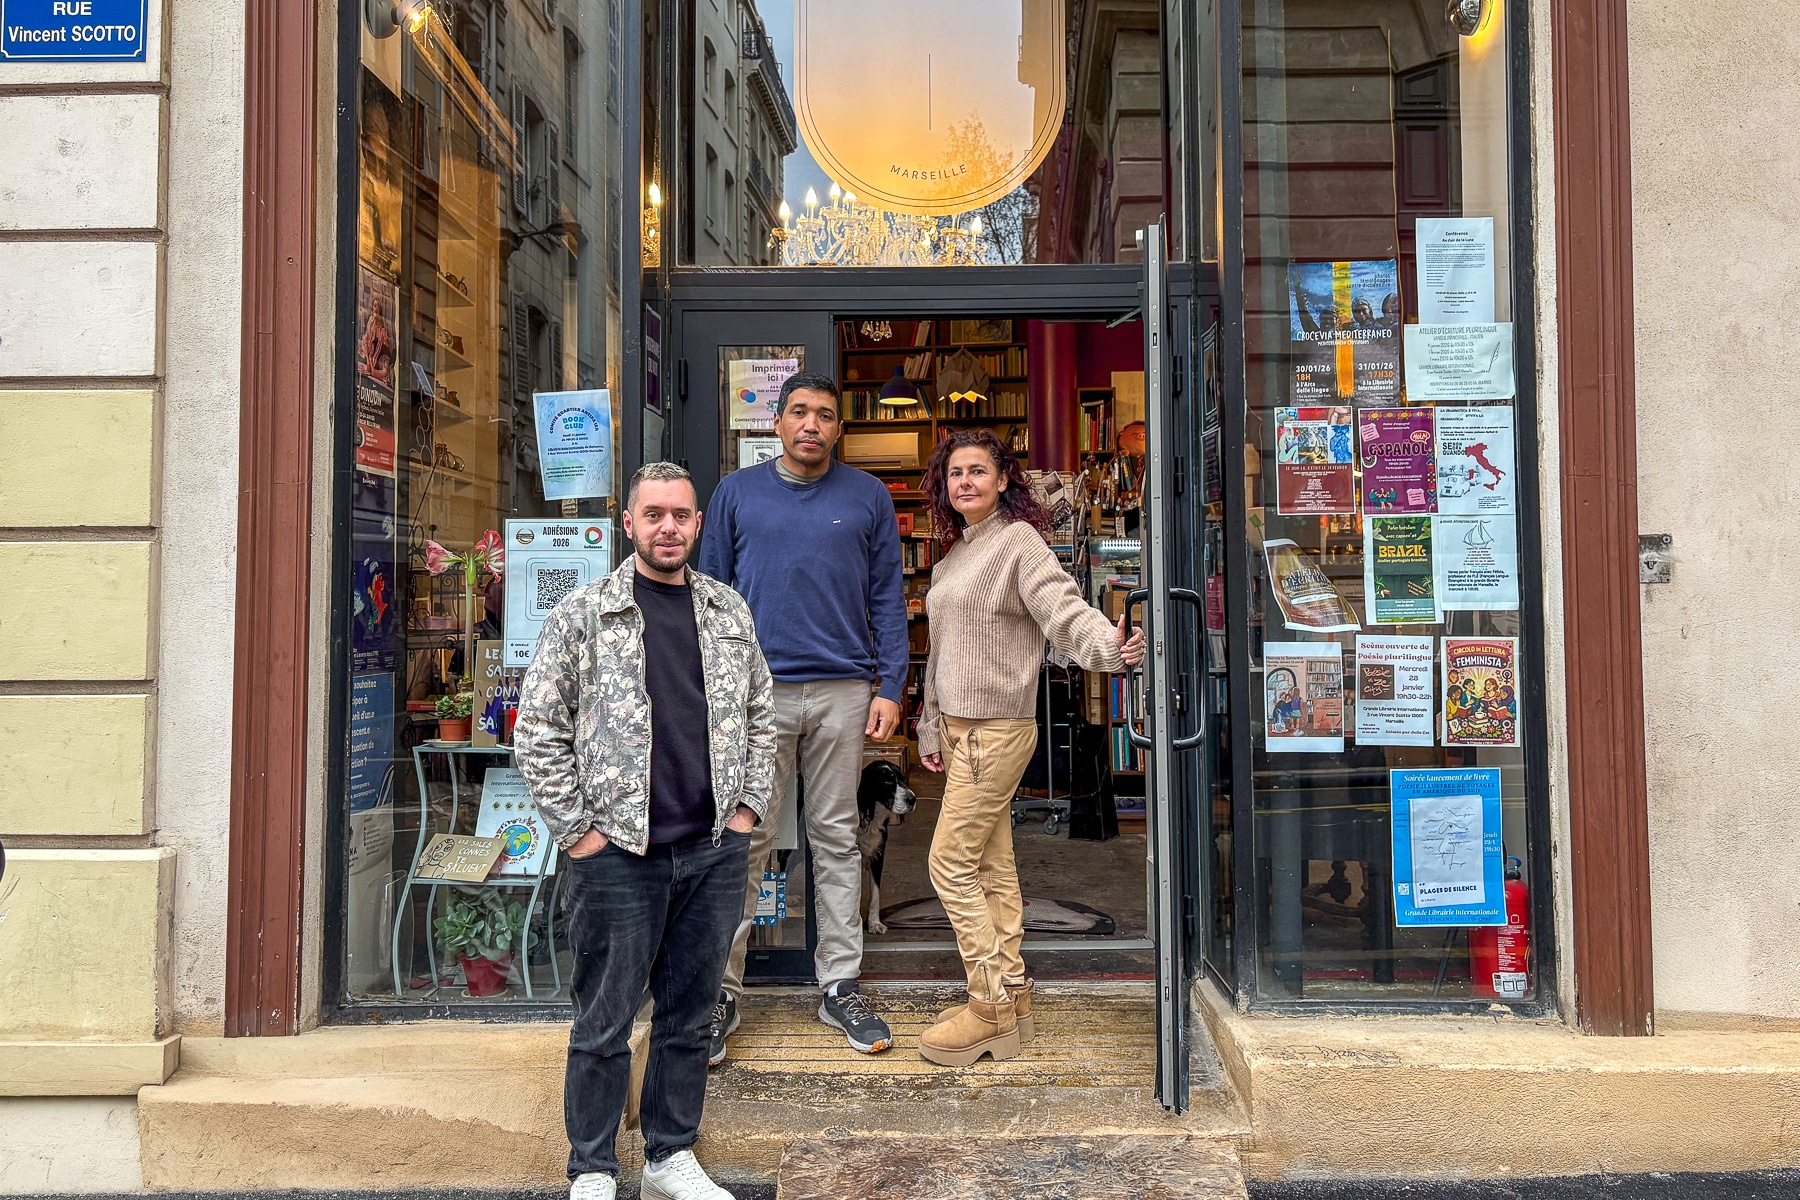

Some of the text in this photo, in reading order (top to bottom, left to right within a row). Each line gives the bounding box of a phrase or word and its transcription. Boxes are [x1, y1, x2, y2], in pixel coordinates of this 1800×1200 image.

[53, 1, 93, 16] RUE
[8, 25, 136, 42] Vincent SCOTTO
[890, 164, 967, 181] MARSEILLE
[752, 364, 796, 374] Imprimez
[1296, 365, 1331, 373] 30/01/26
[1358, 362, 1394, 371] 31/01/26
[767, 374, 778, 382] ici
[1296, 373, 1311, 381] 18H
[562, 416, 585, 424] BOOK
[564, 422, 584, 430] CLUB
[1369, 440, 1428, 456] ESPAÑOL
[1442, 442, 1453, 450] SE
[542, 525, 579, 536] ADHÉSIONS
[552, 538, 570, 547] 2026
[1379, 545, 1427, 558] BRAZIL
[485, 648, 503, 660] LE
[514, 650, 530, 658] 10€
[1454, 646, 1475, 655] CIRCOLO
[1481, 646, 1506, 655] LETTURA
[1384, 653, 1432, 661] plurilingue
[1456, 656, 1502, 667] FEMMINISTA
[354, 680, 377, 690] souhaitez
[361, 710, 375, 719] d'une
[368, 741, 374, 749] de
[1404, 774, 1426, 782] Soirée
[459, 848, 490, 856] CONNES
[456, 856, 466, 864] TE
[444, 862, 487, 873] SALUENT
[1420, 887, 1443, 895] PLAGES
